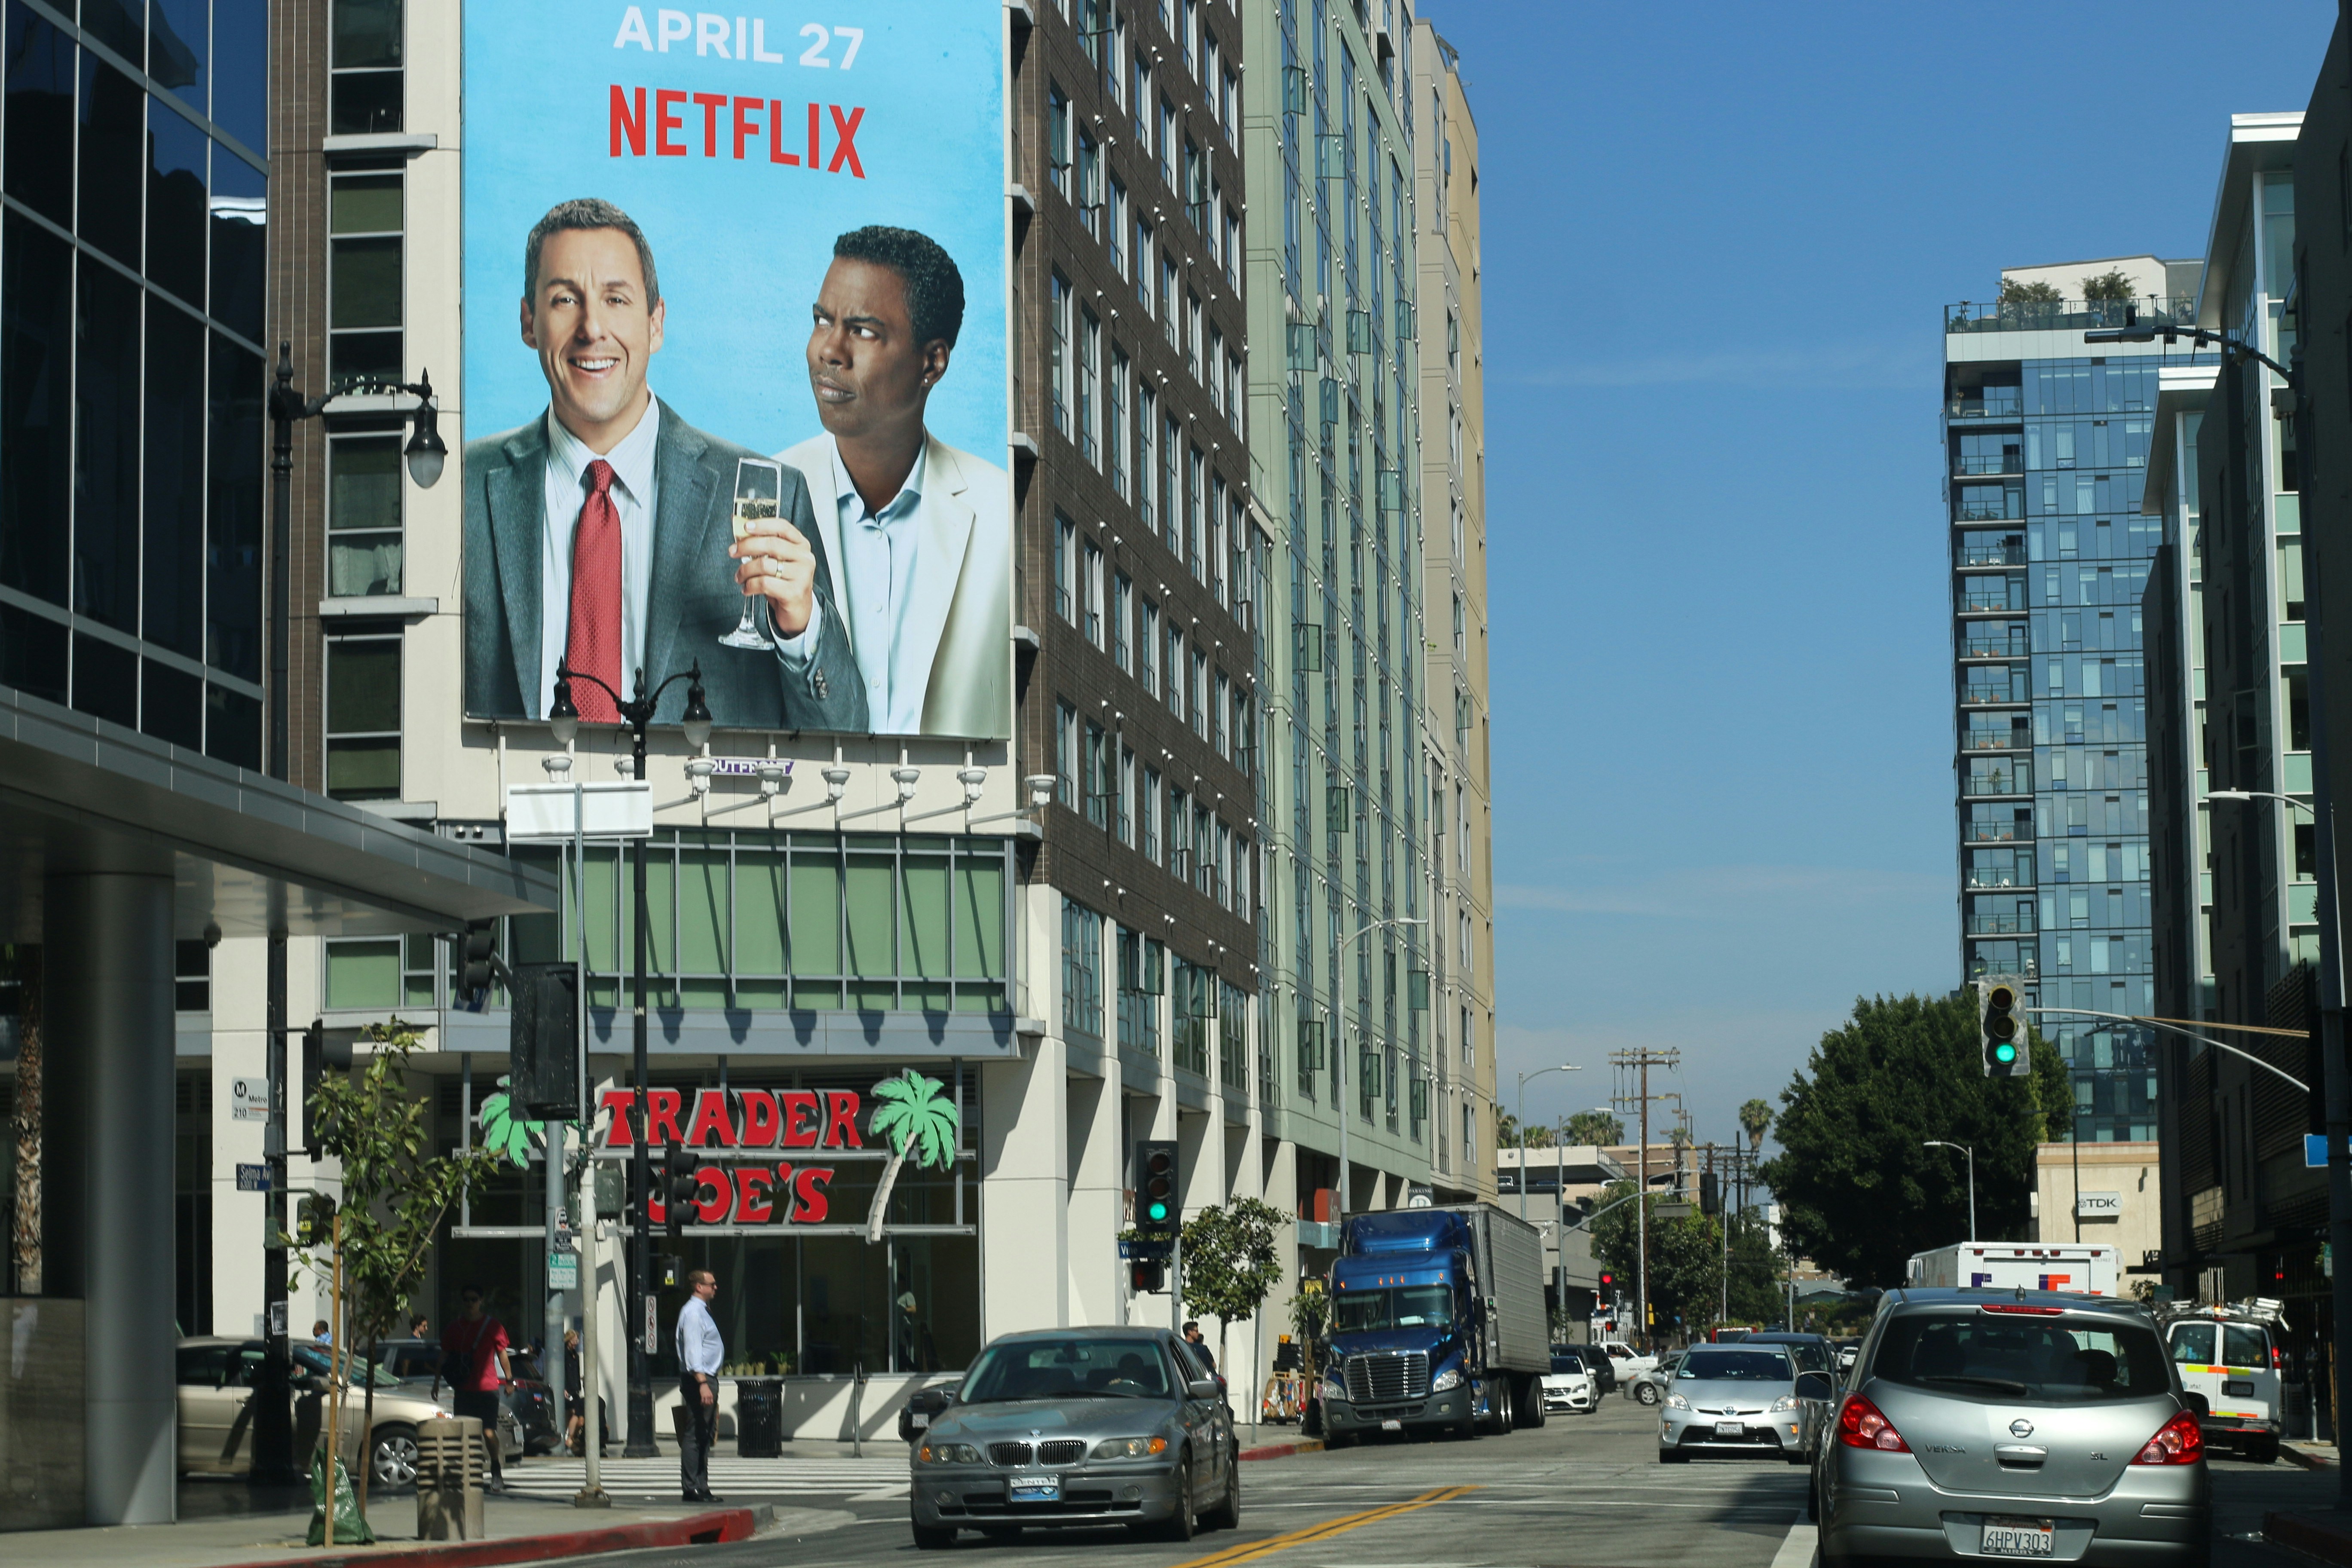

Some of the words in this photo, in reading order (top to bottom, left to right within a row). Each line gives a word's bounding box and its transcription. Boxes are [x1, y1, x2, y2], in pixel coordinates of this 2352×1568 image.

[613, 5, 783, 64] APRIL
[799, 23, 864, 70] 27
[610, 84, 866, 180] NETFLIX
[248, 1094, 267, 1103] Metro
[234, 1107, 246, 1118] 210
[601, 1090, 863, 1147] TRADER
[241, 1164, 260, 1181] Selma
[262, 1166, 270, 1181] Av
[2086, 1198, 2117, 1207] TDK
[1120, 1245, 1138, 1255] Vine
[1925, 1444, 1966, 1455] VERSA
[2091, 1451, 2108, 1461] SL
[1986, 1530, 2050, 1551] 6HPV303
